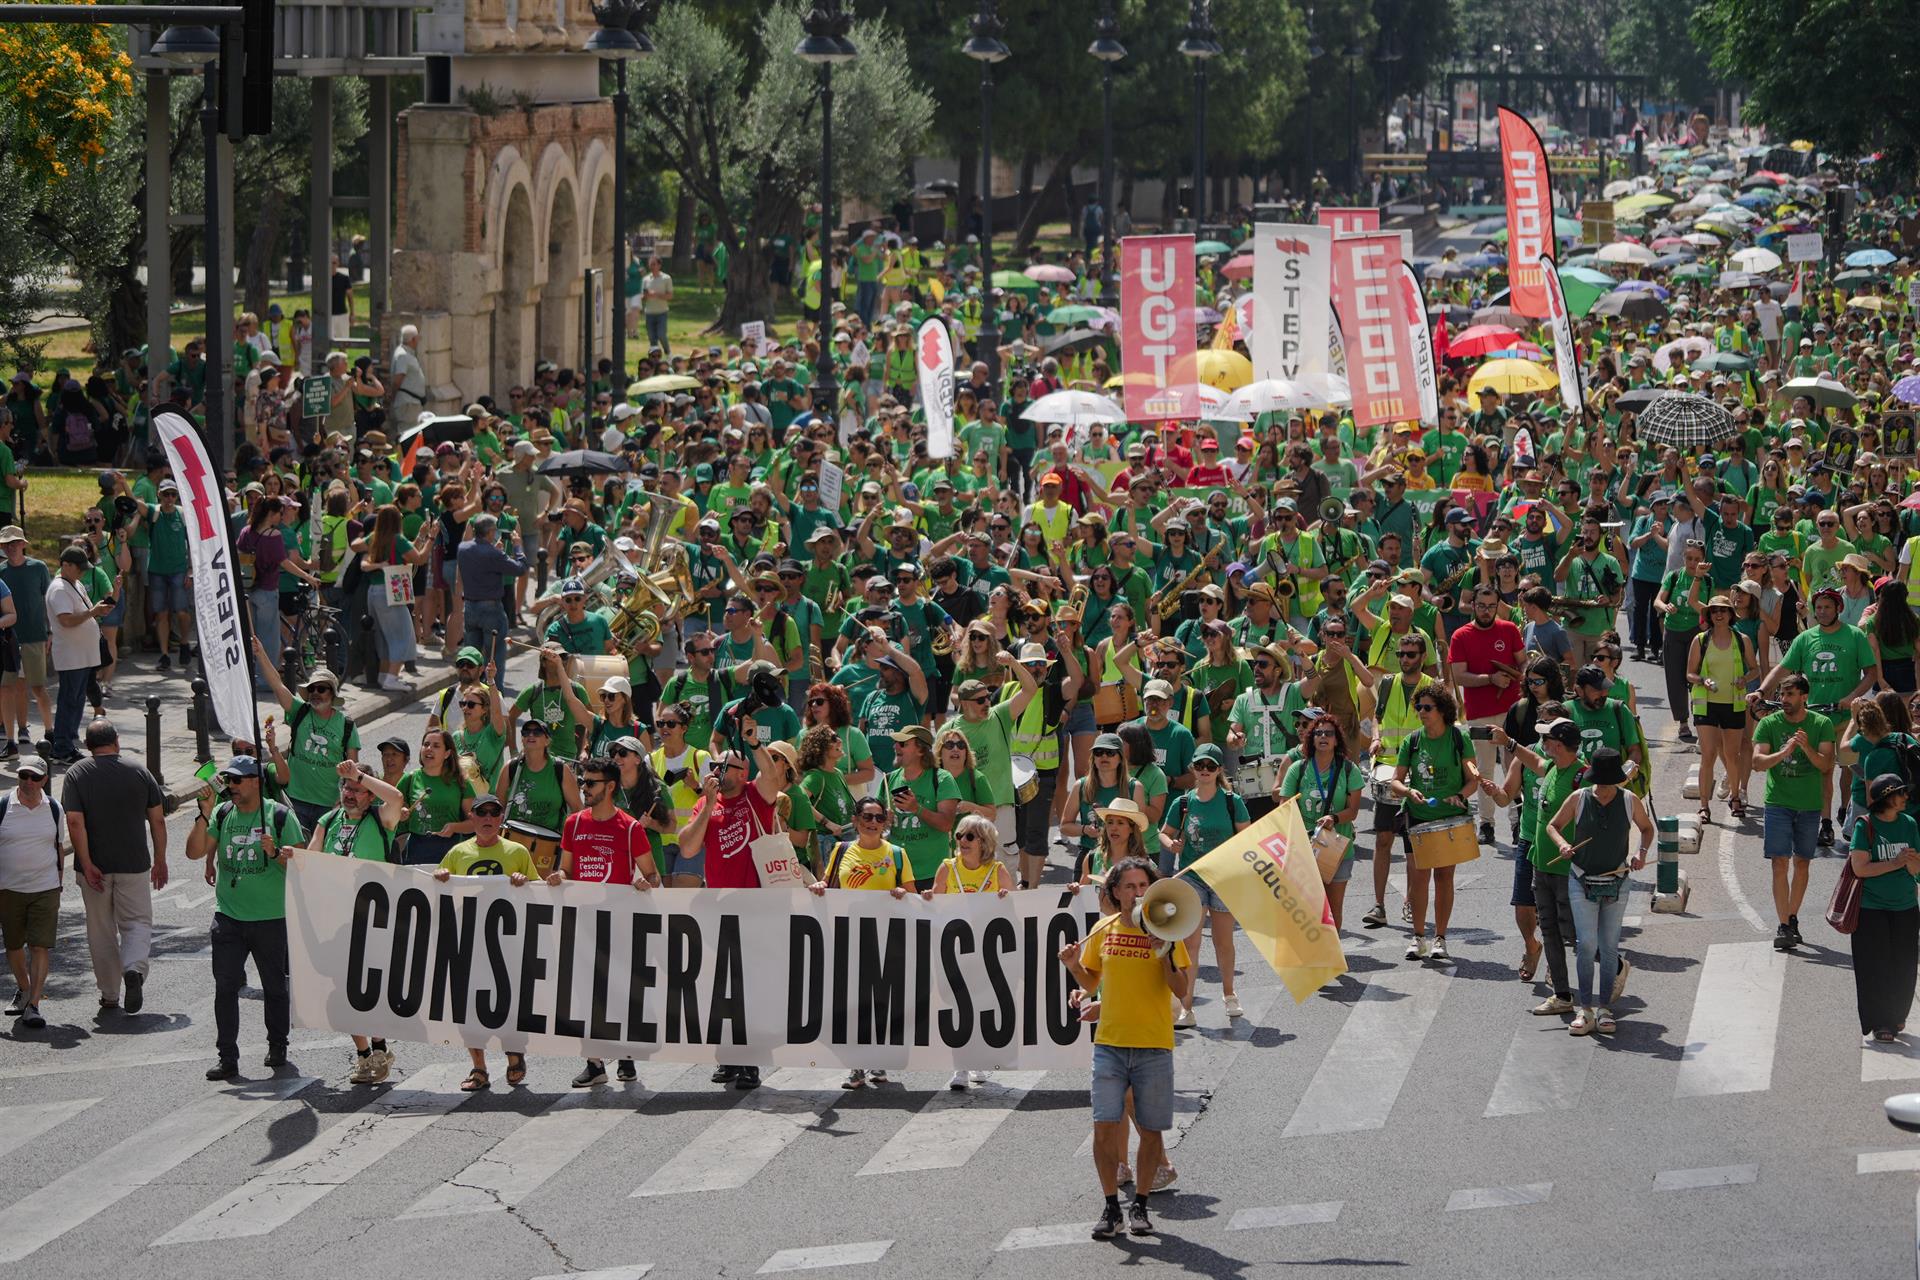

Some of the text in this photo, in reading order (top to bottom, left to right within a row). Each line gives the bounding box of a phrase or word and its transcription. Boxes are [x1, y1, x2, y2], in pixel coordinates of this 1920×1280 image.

[1140, 248, 1177, 389] UGT
[1282, 258, 1301, 381] STEPV
[1352, 244, 1401, 395] CCOO
[579, 855, 604, 863] Salvem
[579, 870, 604, 879] pública
[720, 835, 744, 851] pública
[765, 859, 788, 874] UGT
[1242, 850, 1322, 943] educació
[346, 881, 1100, 1049] CONSELLERA DIMISSIÓ
